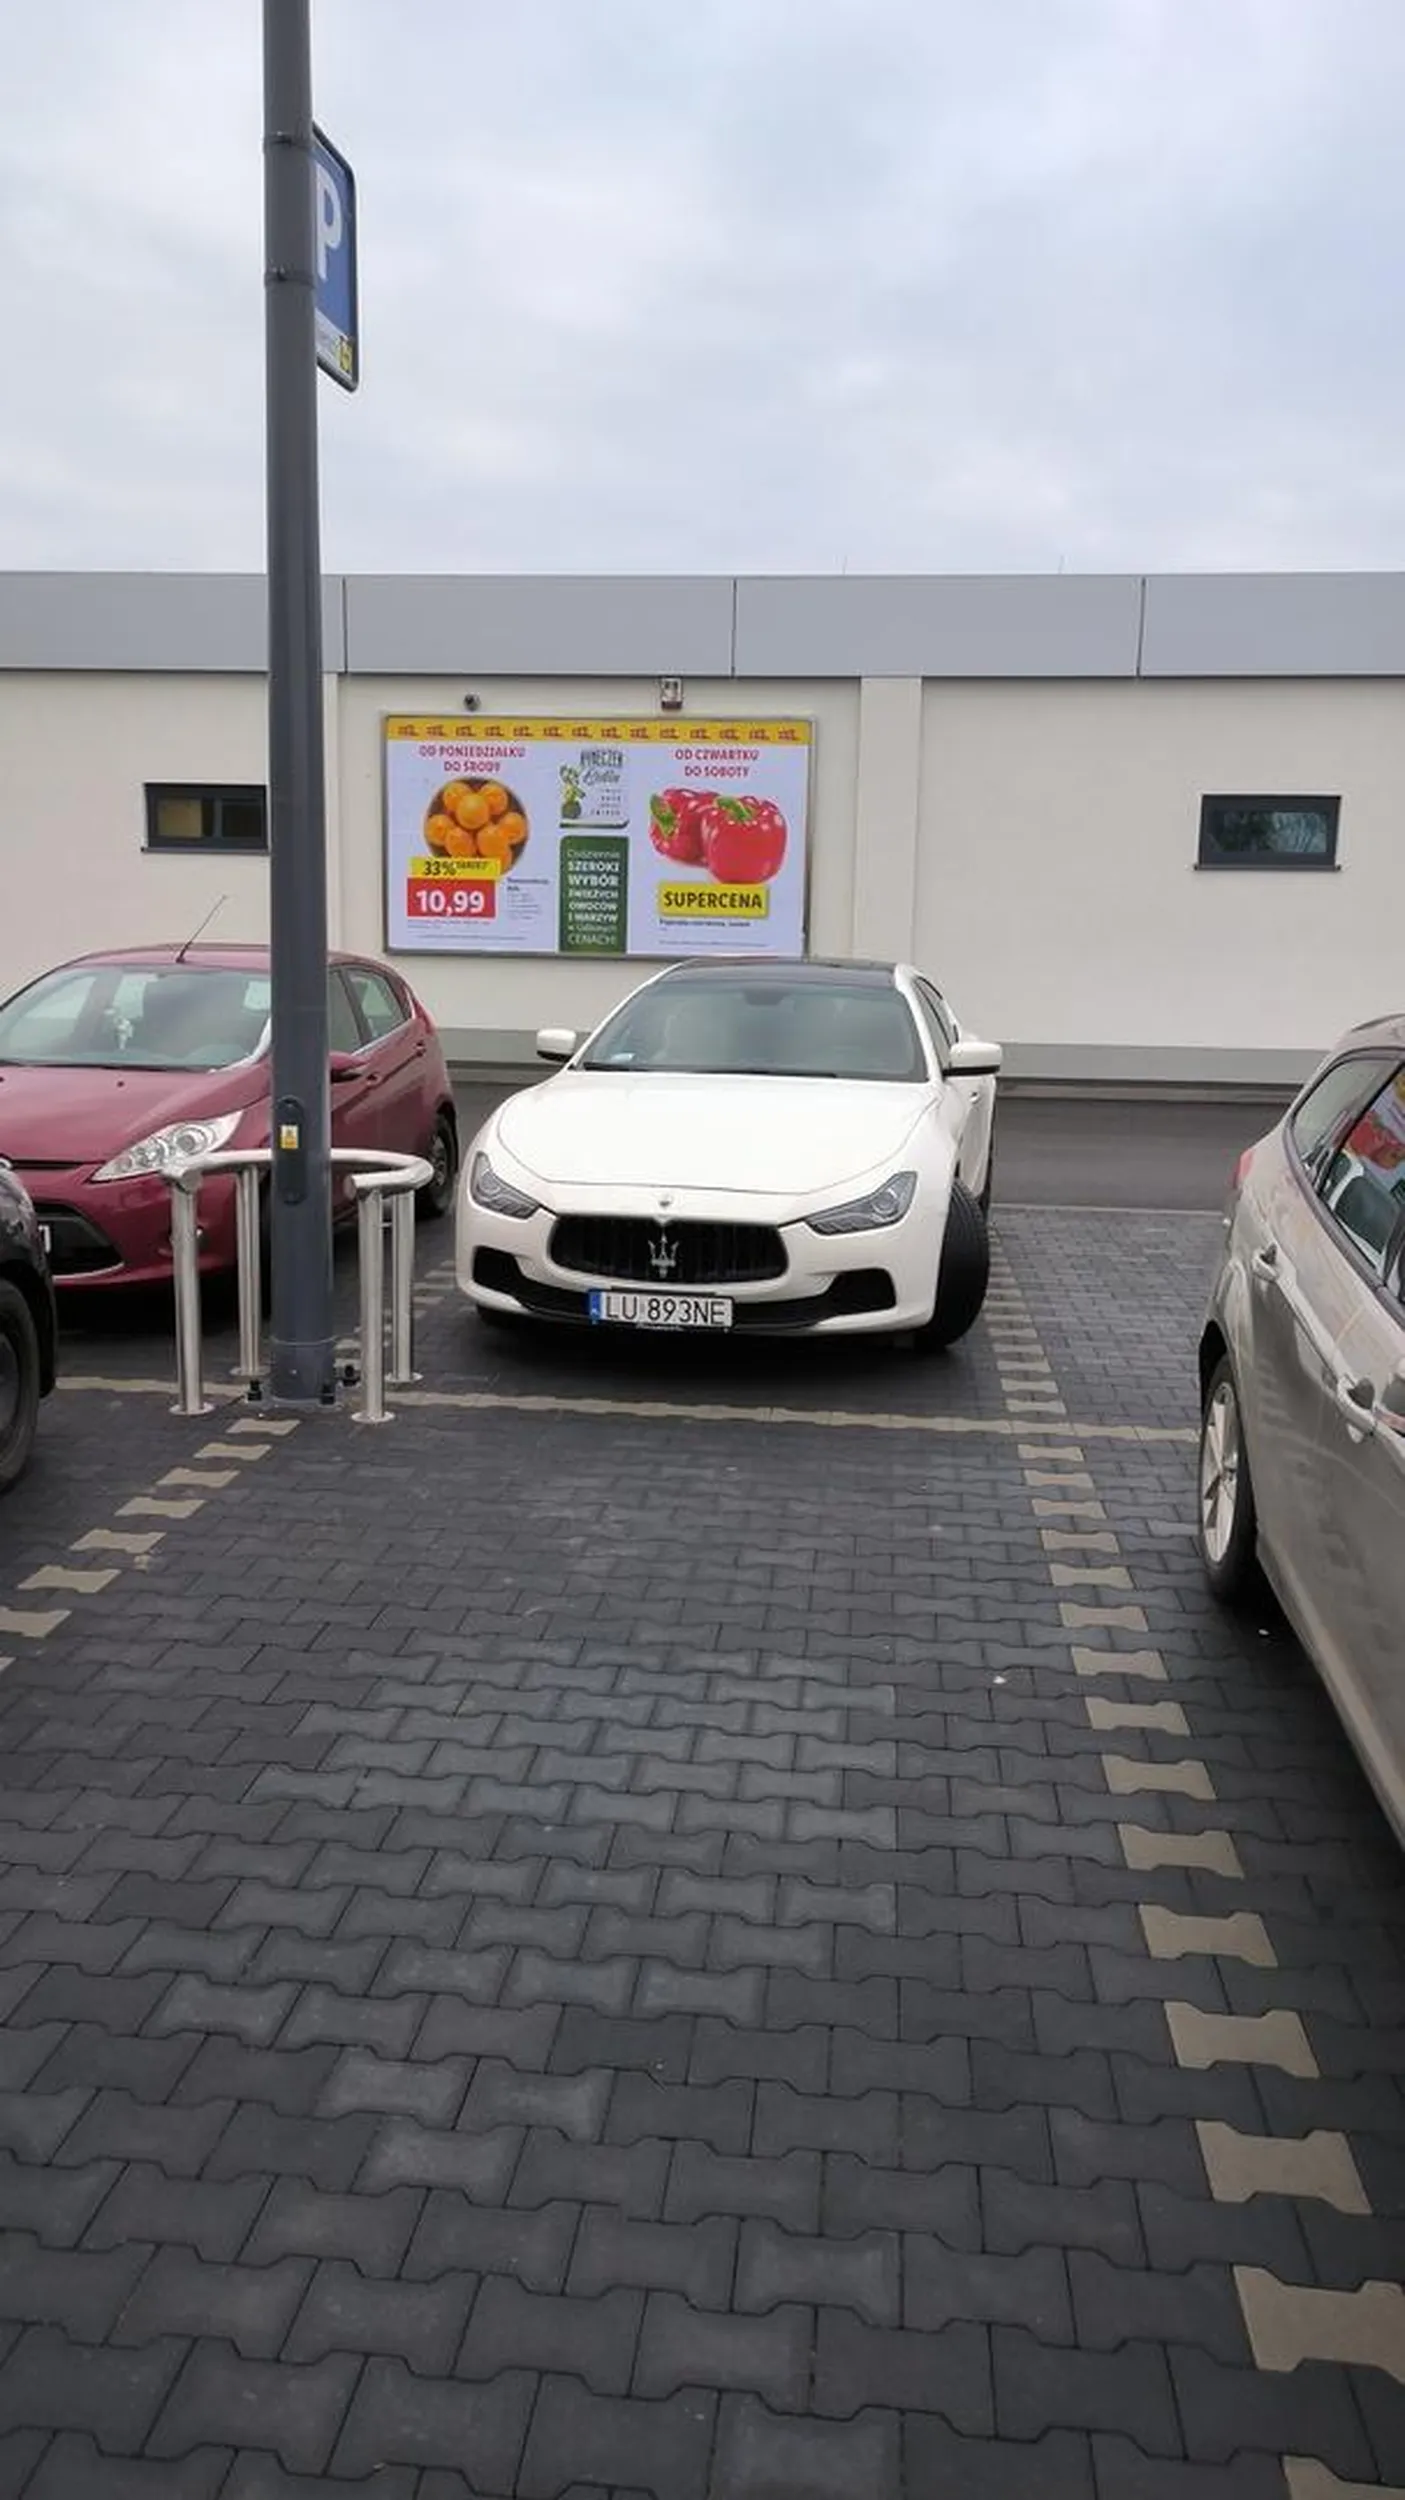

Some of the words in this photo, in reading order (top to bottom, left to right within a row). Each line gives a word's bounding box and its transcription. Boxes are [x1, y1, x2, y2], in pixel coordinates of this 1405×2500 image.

[316, 163, 341, 281] P
[419, 745, 437, 757] OD
[674, 749, 693, 760] OD
[695, 749, 759, 761] CZWARTKU
[443, 761, 461, 772] DO
[463, 760, 501, 772] ŚRODY
[684, 765, 701, 777] DO
[703, 765, 750, 777] SOBOTY
[423, 860, 457, 876] 33%
[568, 860, 620, 872] SZEROKI
[568, 873, 619, 887] WYBÓR
[415, 889, 485, 916] 10,99
[663, 891, 762, 909] SUPERCENA
[606, 1295, 637, 1320] LU
[647, 1298, 725, 1325] 893NE
